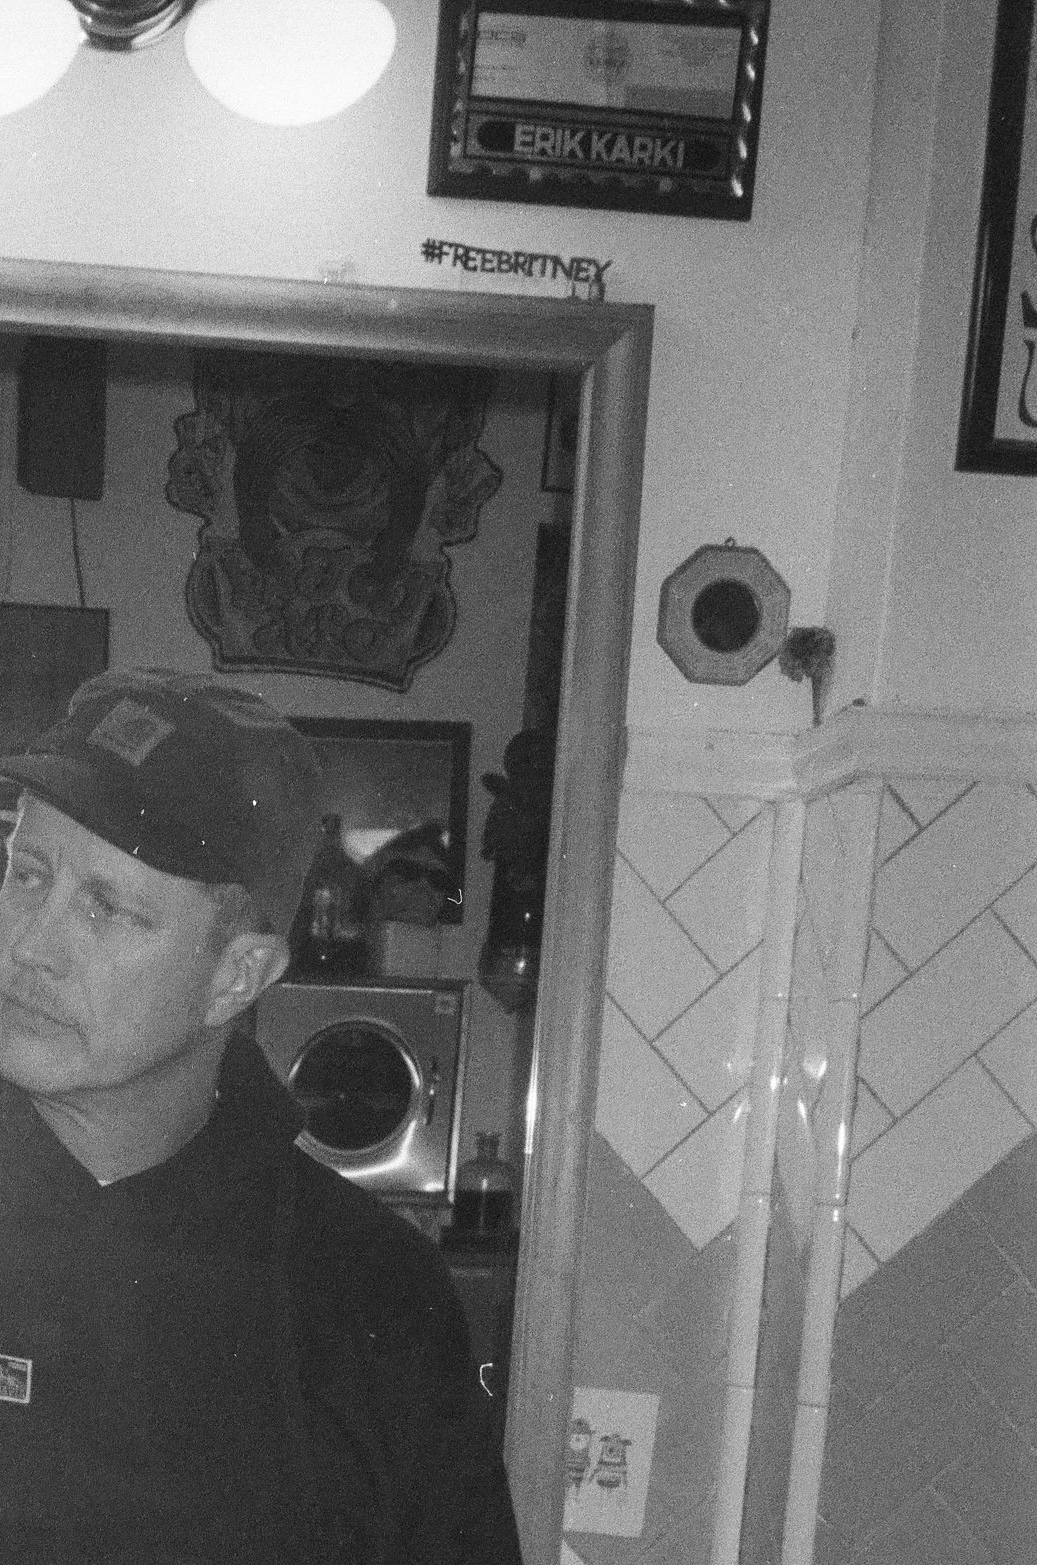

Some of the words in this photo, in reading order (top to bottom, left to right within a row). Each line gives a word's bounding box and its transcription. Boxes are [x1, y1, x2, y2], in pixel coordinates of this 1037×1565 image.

[514, 124, 584, 160] ERIK
[589, 130, 686, 169] KARKI
[420, 237, 613, 284] #FREEBRITNEY
